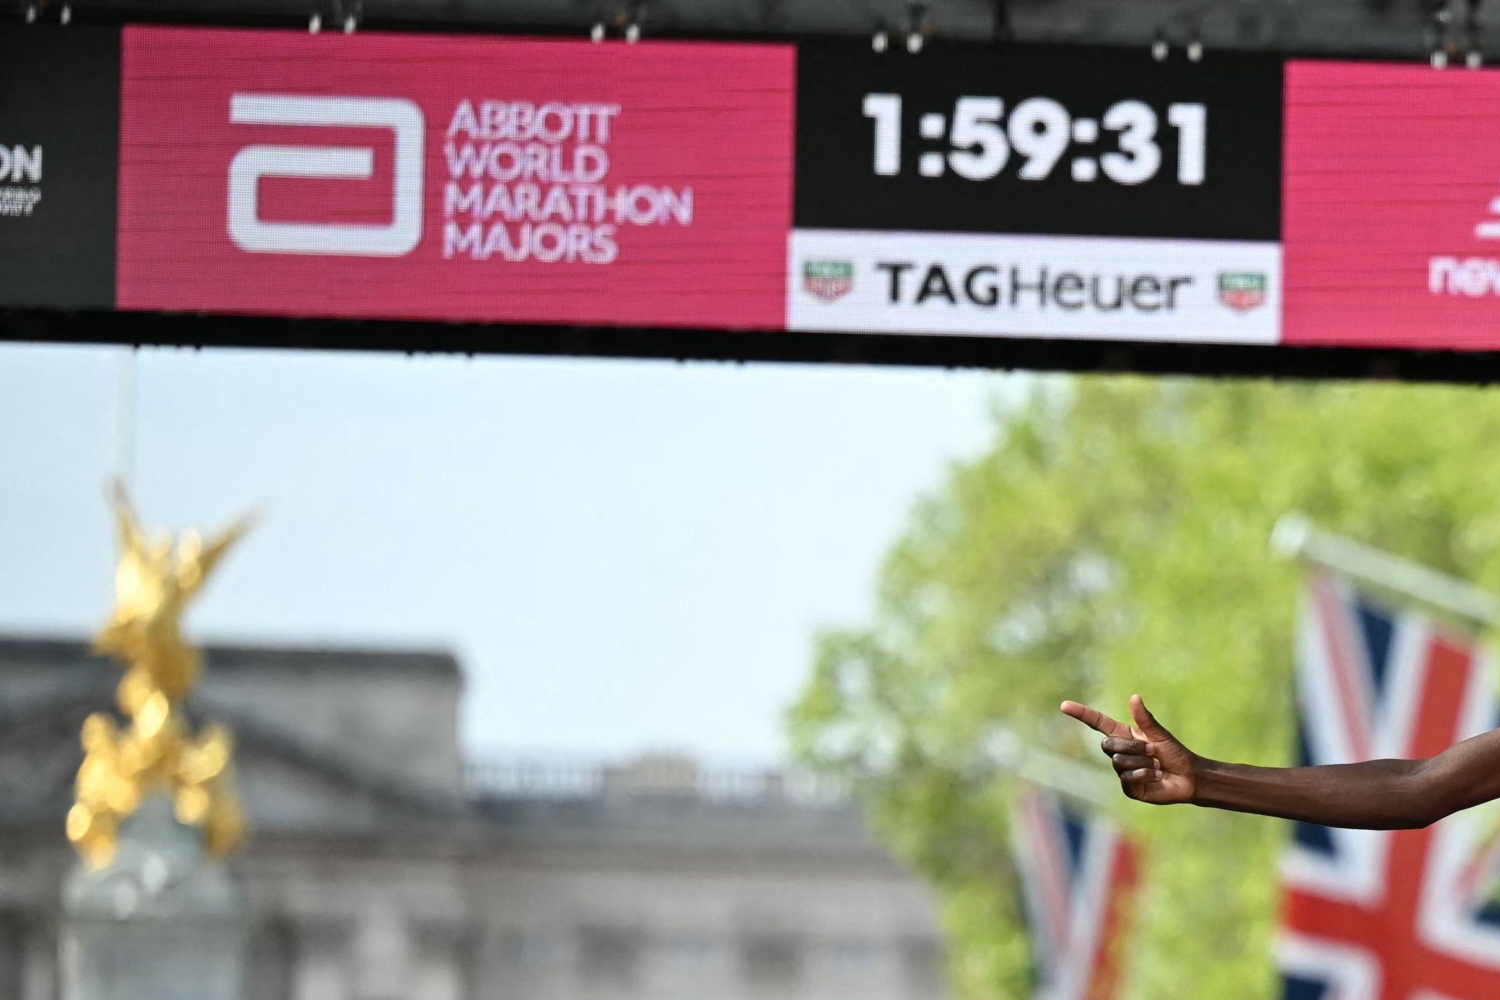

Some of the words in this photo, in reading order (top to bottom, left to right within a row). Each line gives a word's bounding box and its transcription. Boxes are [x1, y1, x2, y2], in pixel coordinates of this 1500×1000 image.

[447, 100, 621, 144] ABBOTT
[862, 94, 1207, 186] 1:59:31
[445, 143, 610, 184] WORLD
[445, 181, 693, 227] MARATHON
[443, 221, 619, 264] MAJORS
